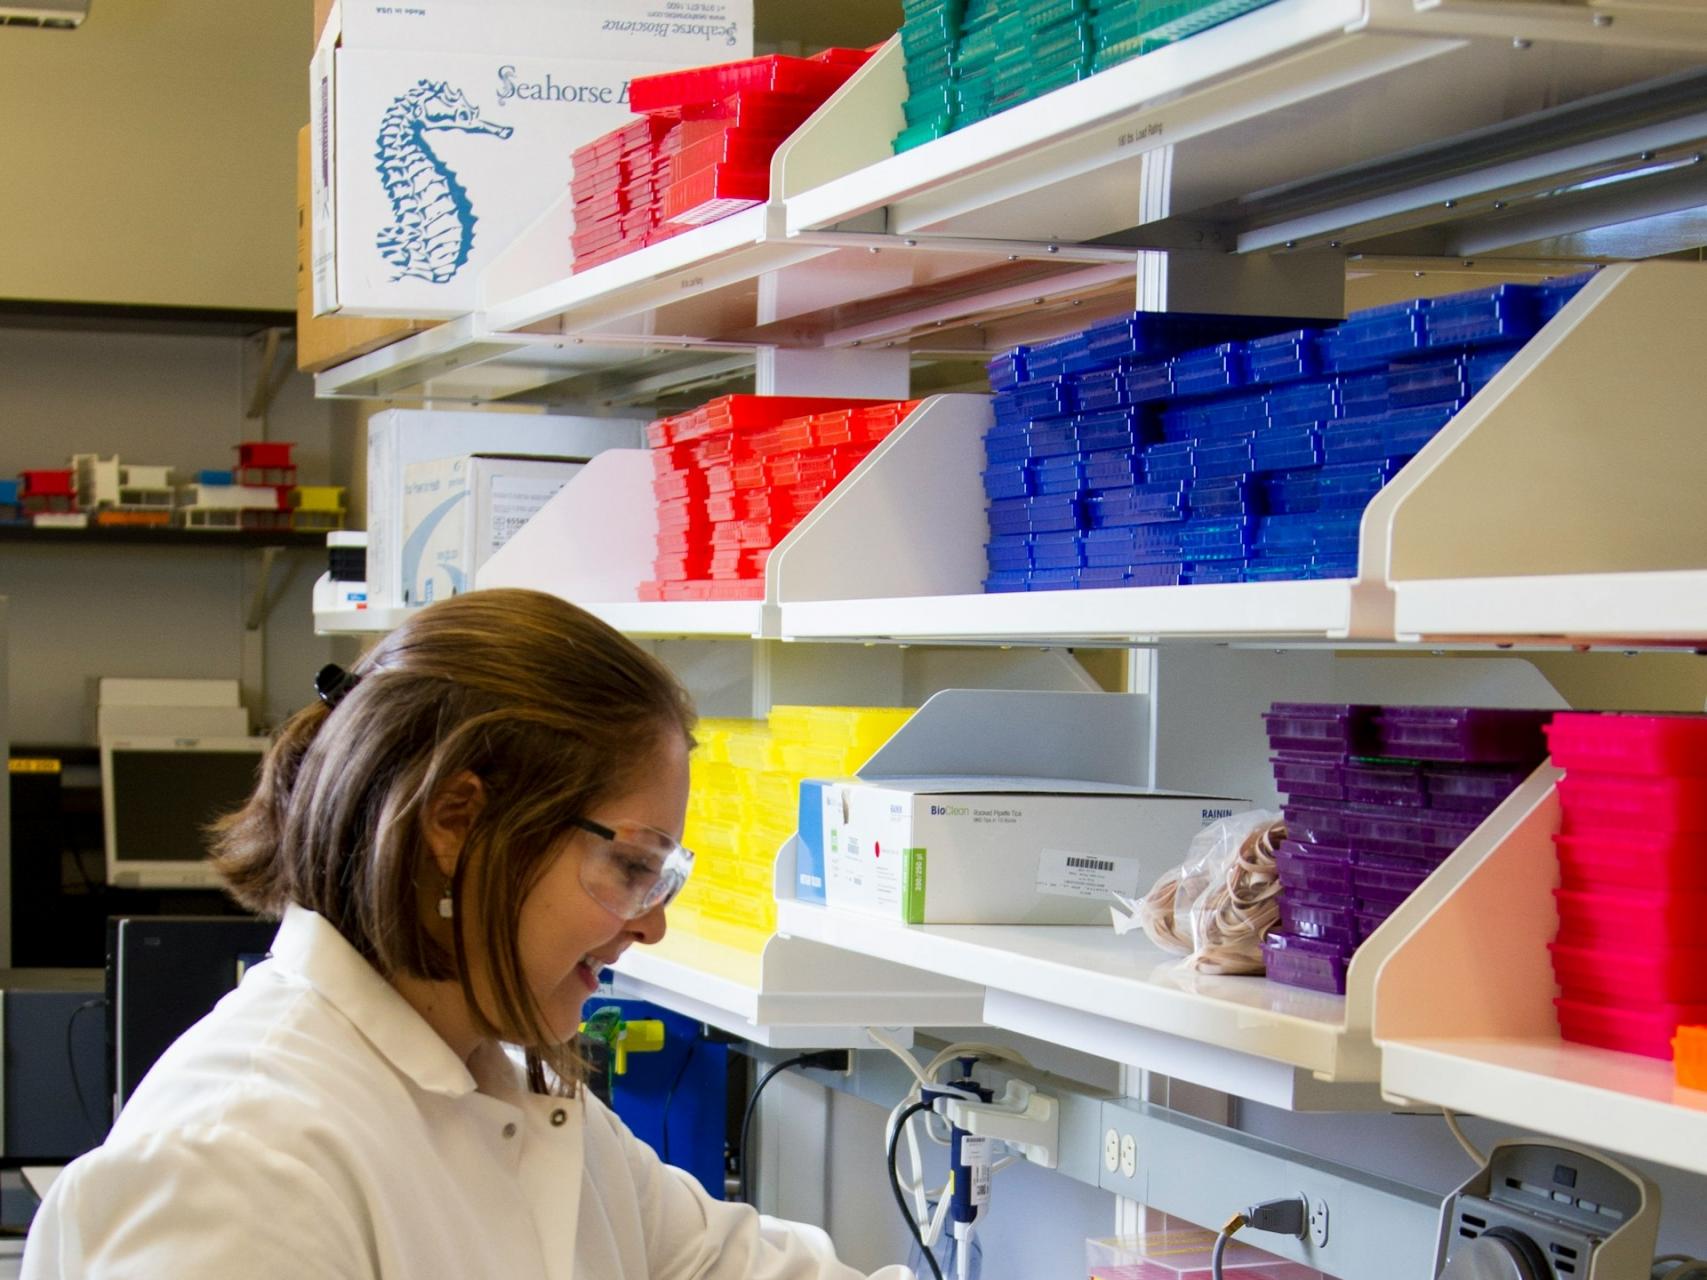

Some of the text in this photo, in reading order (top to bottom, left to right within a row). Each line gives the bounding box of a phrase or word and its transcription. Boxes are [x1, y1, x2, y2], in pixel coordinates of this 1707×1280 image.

[376, 7, 393, 15] USA
[405, 8, 426, 16] Made
[602, 19, 738, 46] Seahorse Bioscience
[496, 64, 613, 107] Seahorse
[1202, 808, 1233, 819] RAININ
